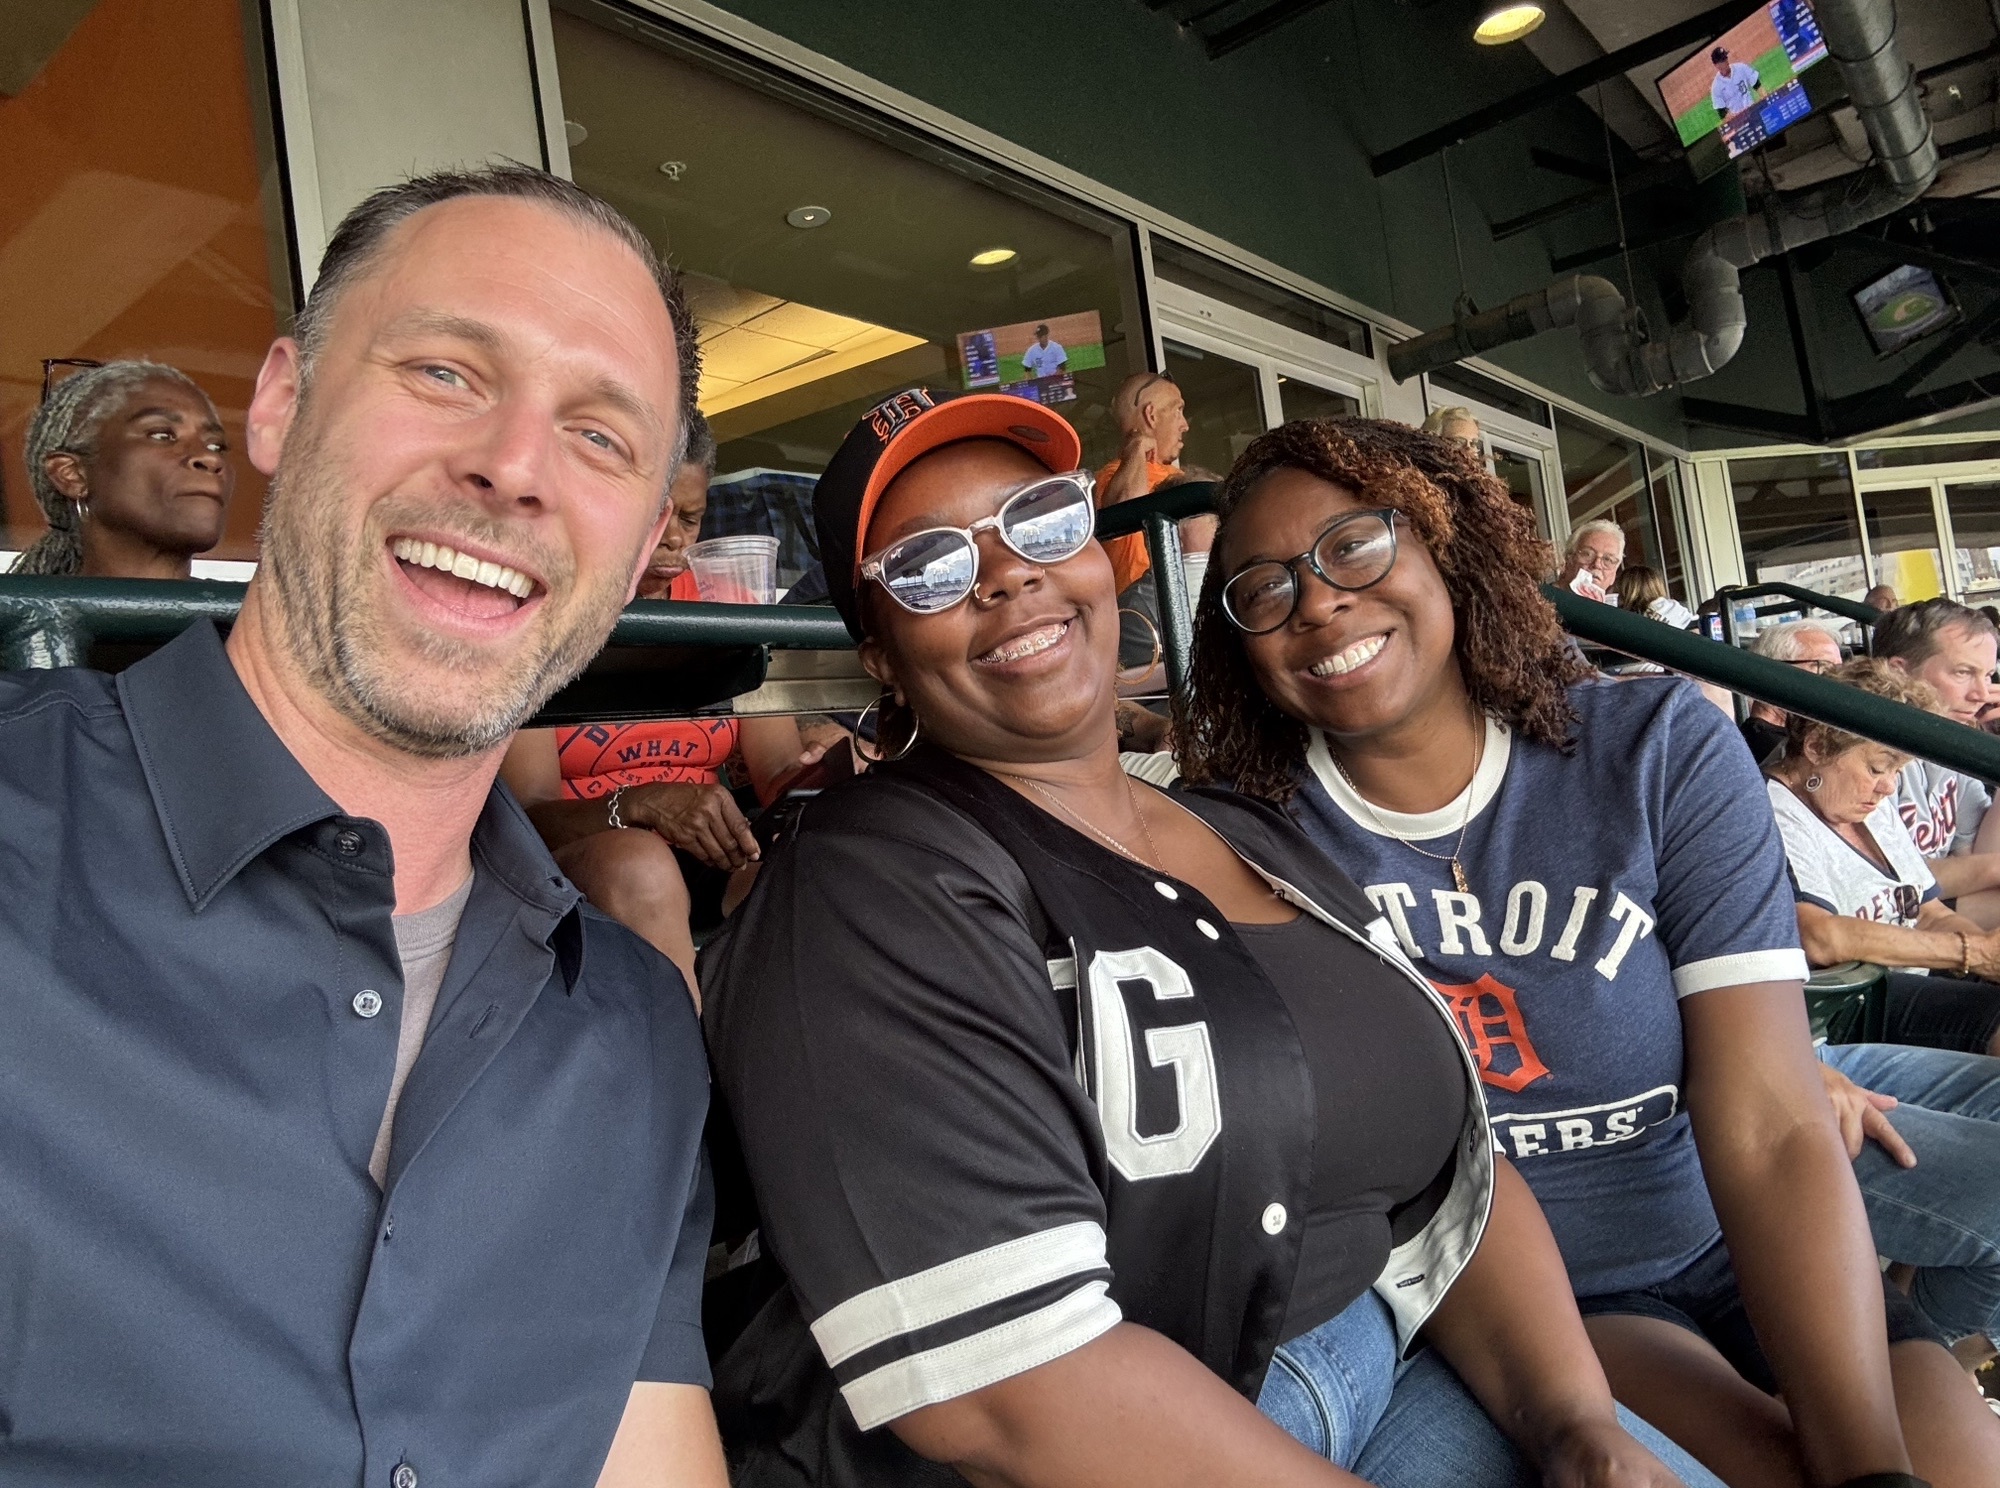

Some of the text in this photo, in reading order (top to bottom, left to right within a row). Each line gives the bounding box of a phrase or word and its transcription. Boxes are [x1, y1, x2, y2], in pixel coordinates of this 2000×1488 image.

[617, 739, 699, 763] WHAT
[618, 769, 643, 784] EST
[1088, 945, 1222, 1182] G
